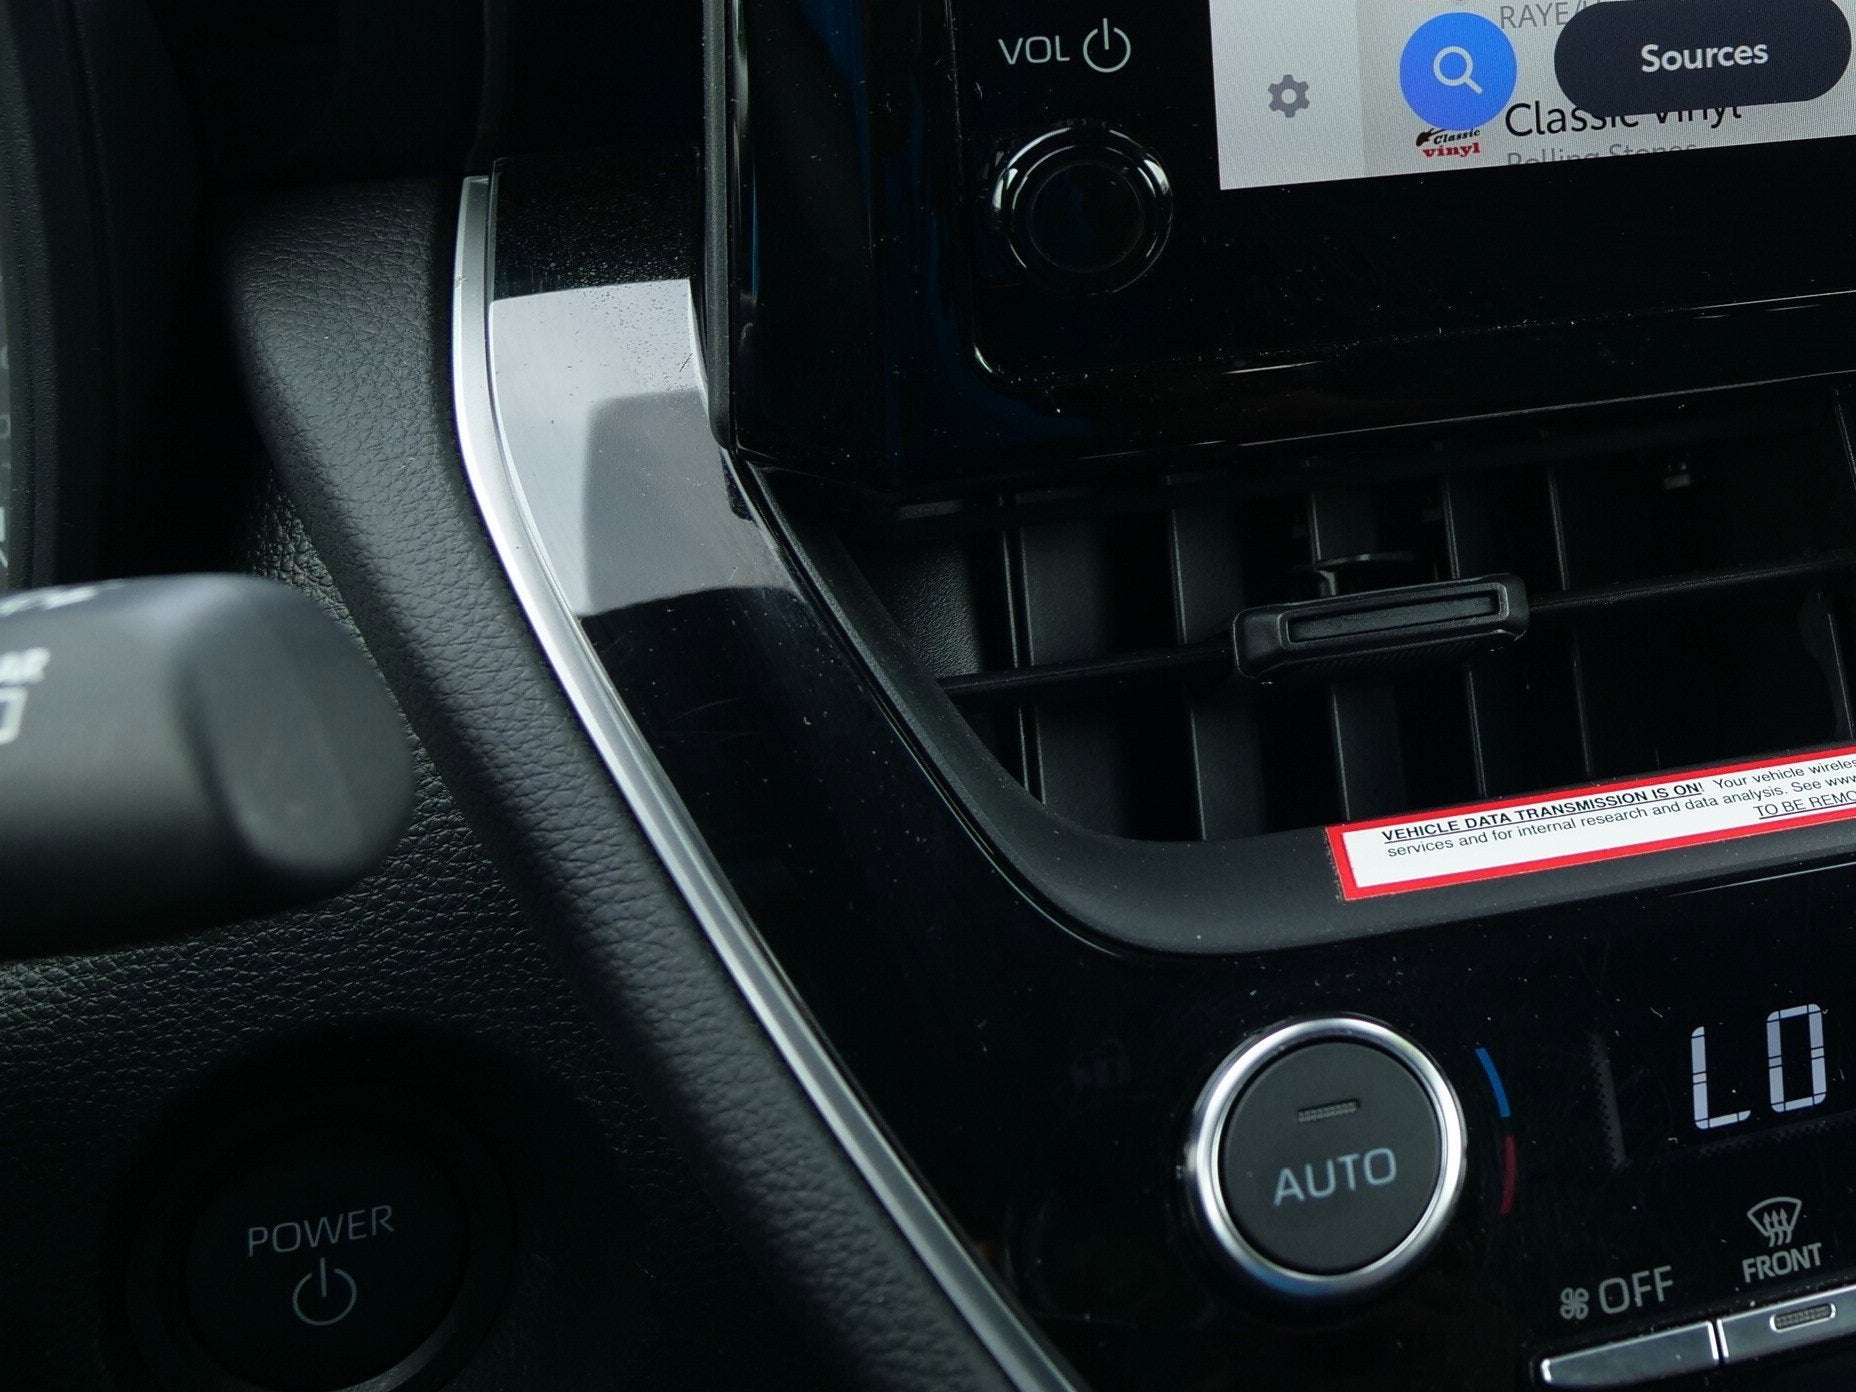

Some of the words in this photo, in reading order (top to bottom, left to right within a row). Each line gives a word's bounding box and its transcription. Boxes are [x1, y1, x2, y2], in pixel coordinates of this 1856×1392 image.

[998, 35, 1070, 65] VOL
[1641, 40, 1770, 75] Sources
[1422, 142, 1482, 158] vinyl
[1433, 128, 1481, 145] Classic
[1381, 819, 1461, 842] VEHICLE
[1464, 812, 1512, 829] DATA
[1514, 789, 1649, 822] TRANSMISSION
[1652, 786, 1670, 800] IS
[1673, 782, 1704, 798] ON!
[1713, 775, 1748, 791] Your
[1752, 766, 1805, 786] vehicle
[1387, 838, 1455, 858] services
[1459, 832, 1488, 847] and
[1491, 828, 1514, 842] for
[1518, 819, 1577, 838] internal
[1580, 806, 1649, 828] research
[1652, 800, 1680, 816] and
[1684, 795, 1719, 811] data
[1722, 784, 1788, 806] analysis.
[1790, 780, 1822, 794] See
[1752, 802, 1779, 818] TO
[1782, 798, 1807, 814] BE
[1691, 1003, 1827, 1129] LO
[1272, 1147, 1398, 1206] AUTO
[248, 1205, 395, 1257] POWER
[1741, 1242, 1823, 1284] FRONT
[1599, 1265, 1675, 1315] OFF
